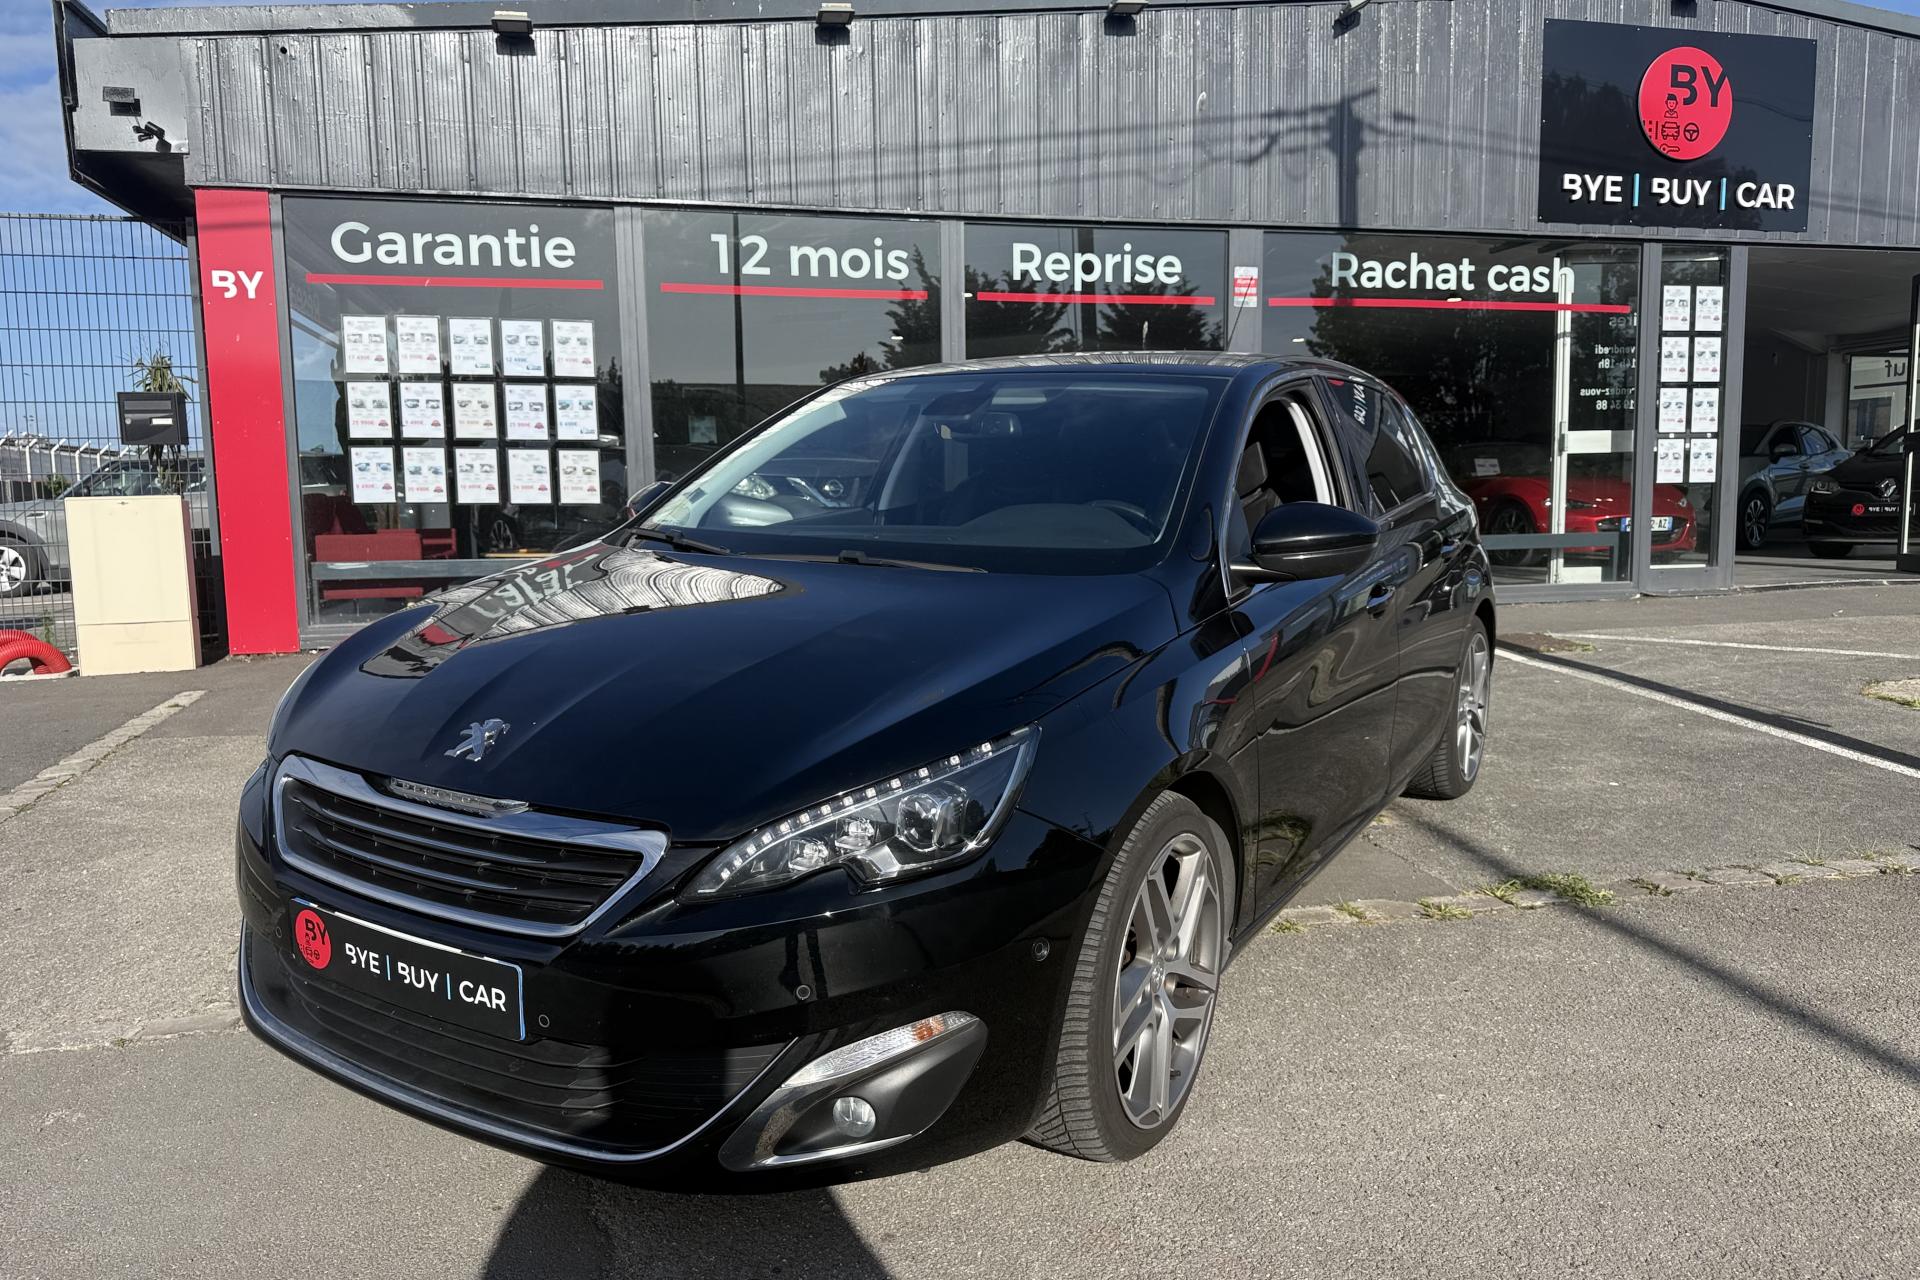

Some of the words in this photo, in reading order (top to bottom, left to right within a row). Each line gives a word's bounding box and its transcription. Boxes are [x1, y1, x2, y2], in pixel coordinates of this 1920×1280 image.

[1669, 63, 1728, 108] BY
[1562, 172, 1624, 203] BYE
[1651, 177, 1713, 206] BUY
[1735, 182, 1796, 211] CAR
[330, 220, 577, 269] Garantie
[710, 233, 771, 276] 12
[789, 236, 911, 281] mois
[1011, 242, 1183, 292] Reprise
[210, 269, 264, 299] BY
[1331, 251, 1476, 292] Rachat
[1486, 256, 1576, 293] cash
[304, 917, 328, 946] BY
[344, 942, 381, 975] BYE
[397, 961, 439, 993] BUY
[458, 980, 507, 1012] CAR
